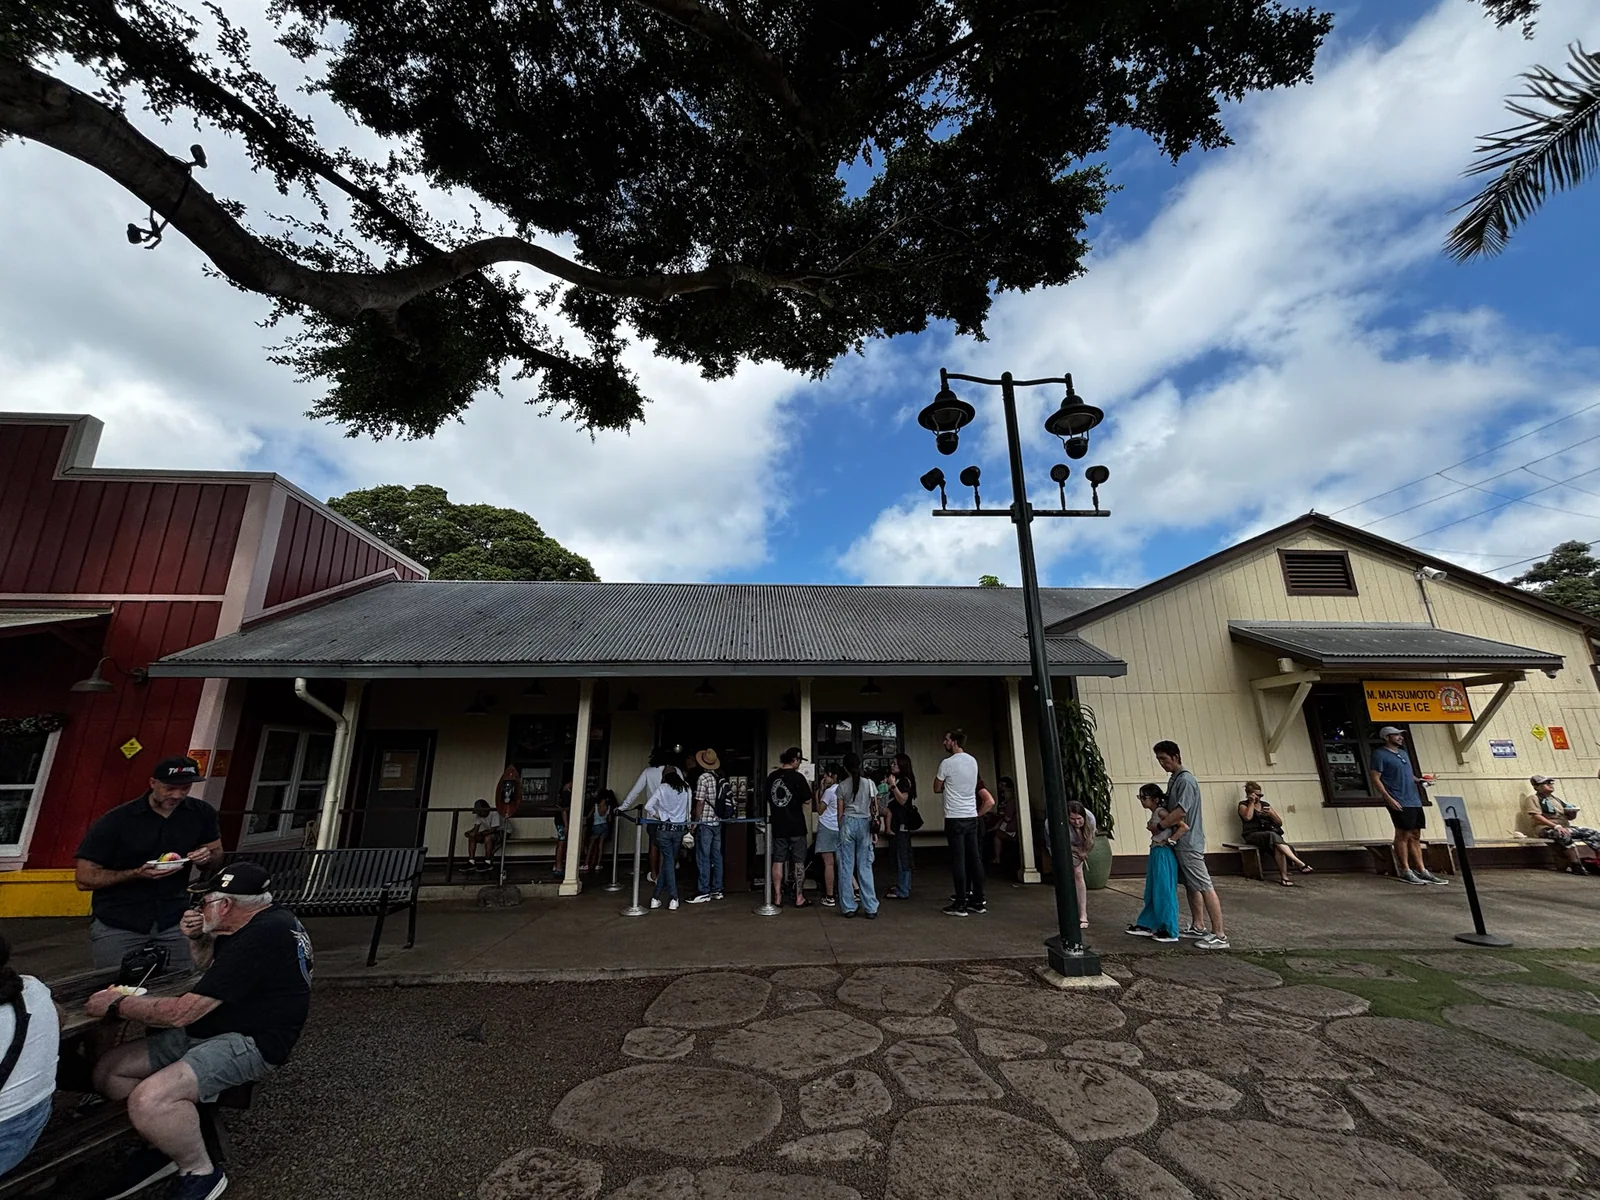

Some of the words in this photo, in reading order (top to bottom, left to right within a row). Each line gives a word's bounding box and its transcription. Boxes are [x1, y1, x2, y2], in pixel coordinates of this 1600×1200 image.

[1366, 690, 1377, 700] M.
[1378, 690, 1436, 700] MATSUMOTO
[1377, 702, 1411, 712] SHAVE
[1414, 702, 1431, 712] ICE
